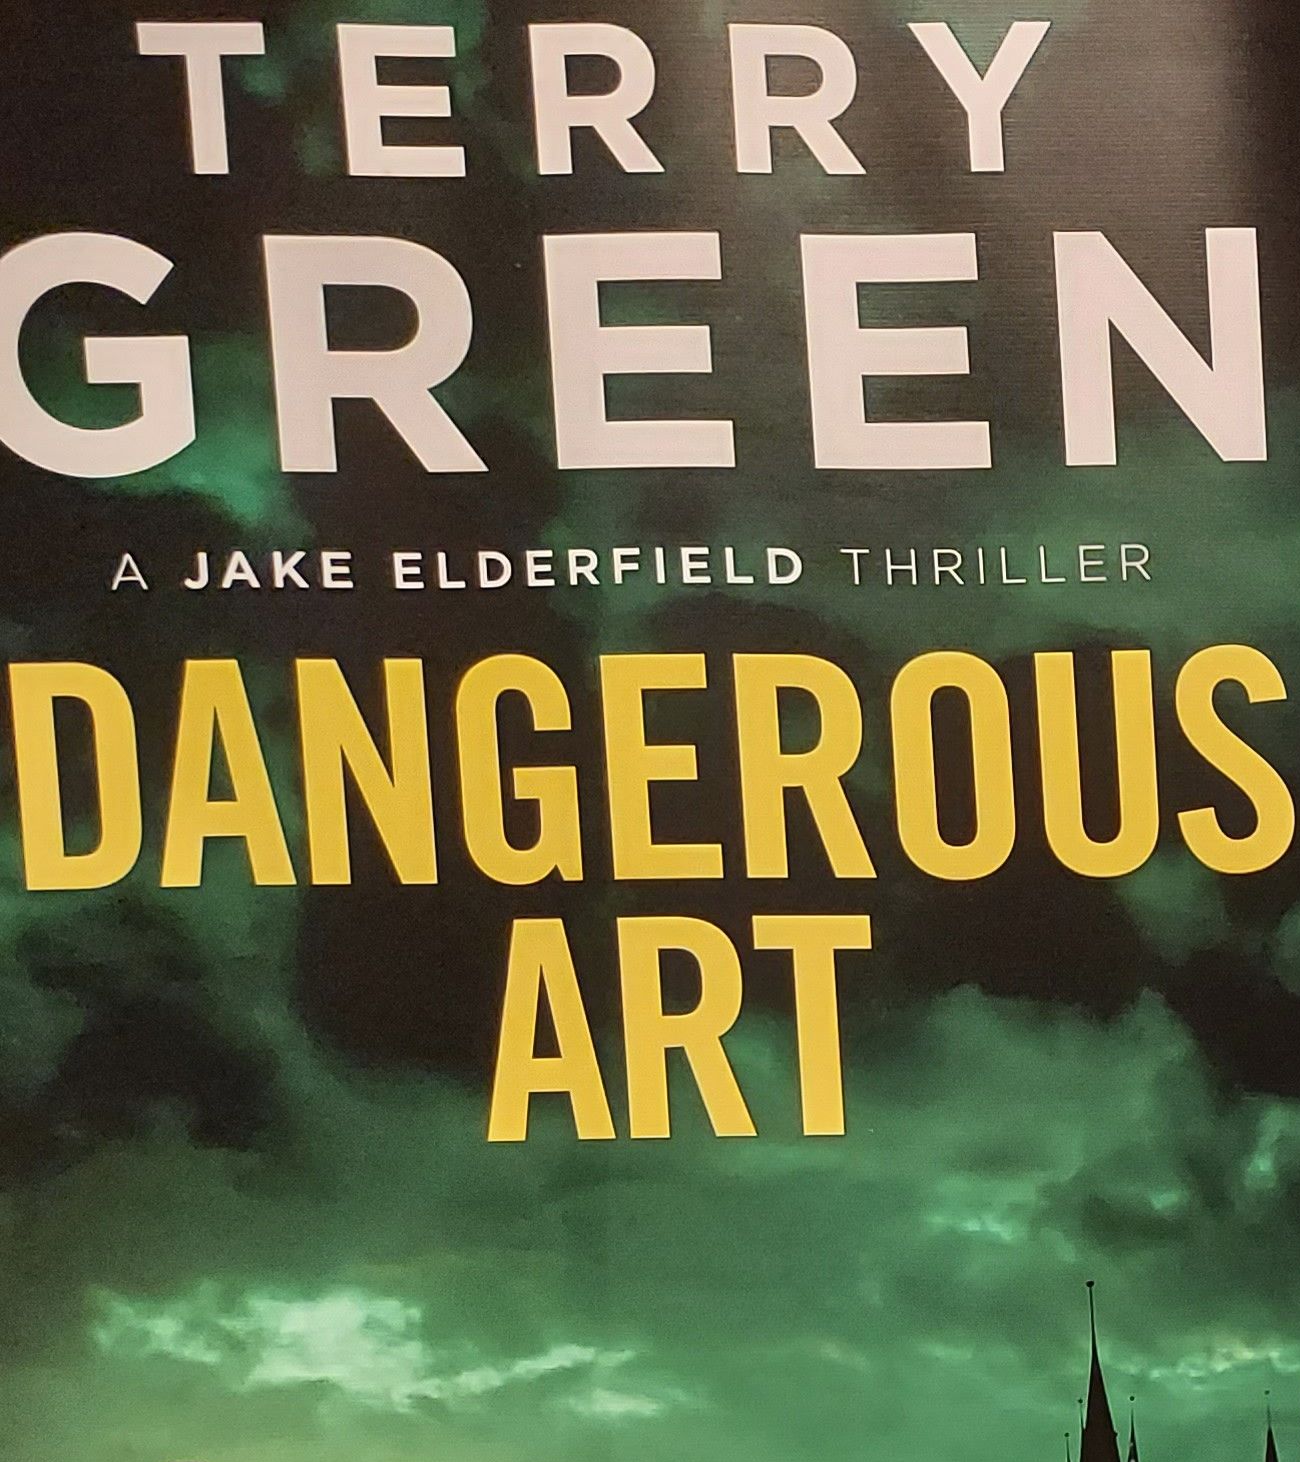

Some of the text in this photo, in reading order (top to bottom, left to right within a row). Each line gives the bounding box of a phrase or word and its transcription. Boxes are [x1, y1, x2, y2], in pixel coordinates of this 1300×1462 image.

[136, 20, 1052, 178] TERRY
[0, 227, 1268, 479] GREEN
[110, 543, 1154, 591] A JAKE ELDERFIELD THRILLER
[8, 644, 1296, 891] DANGEROUS
[487, 914, 872, 1142] ART
